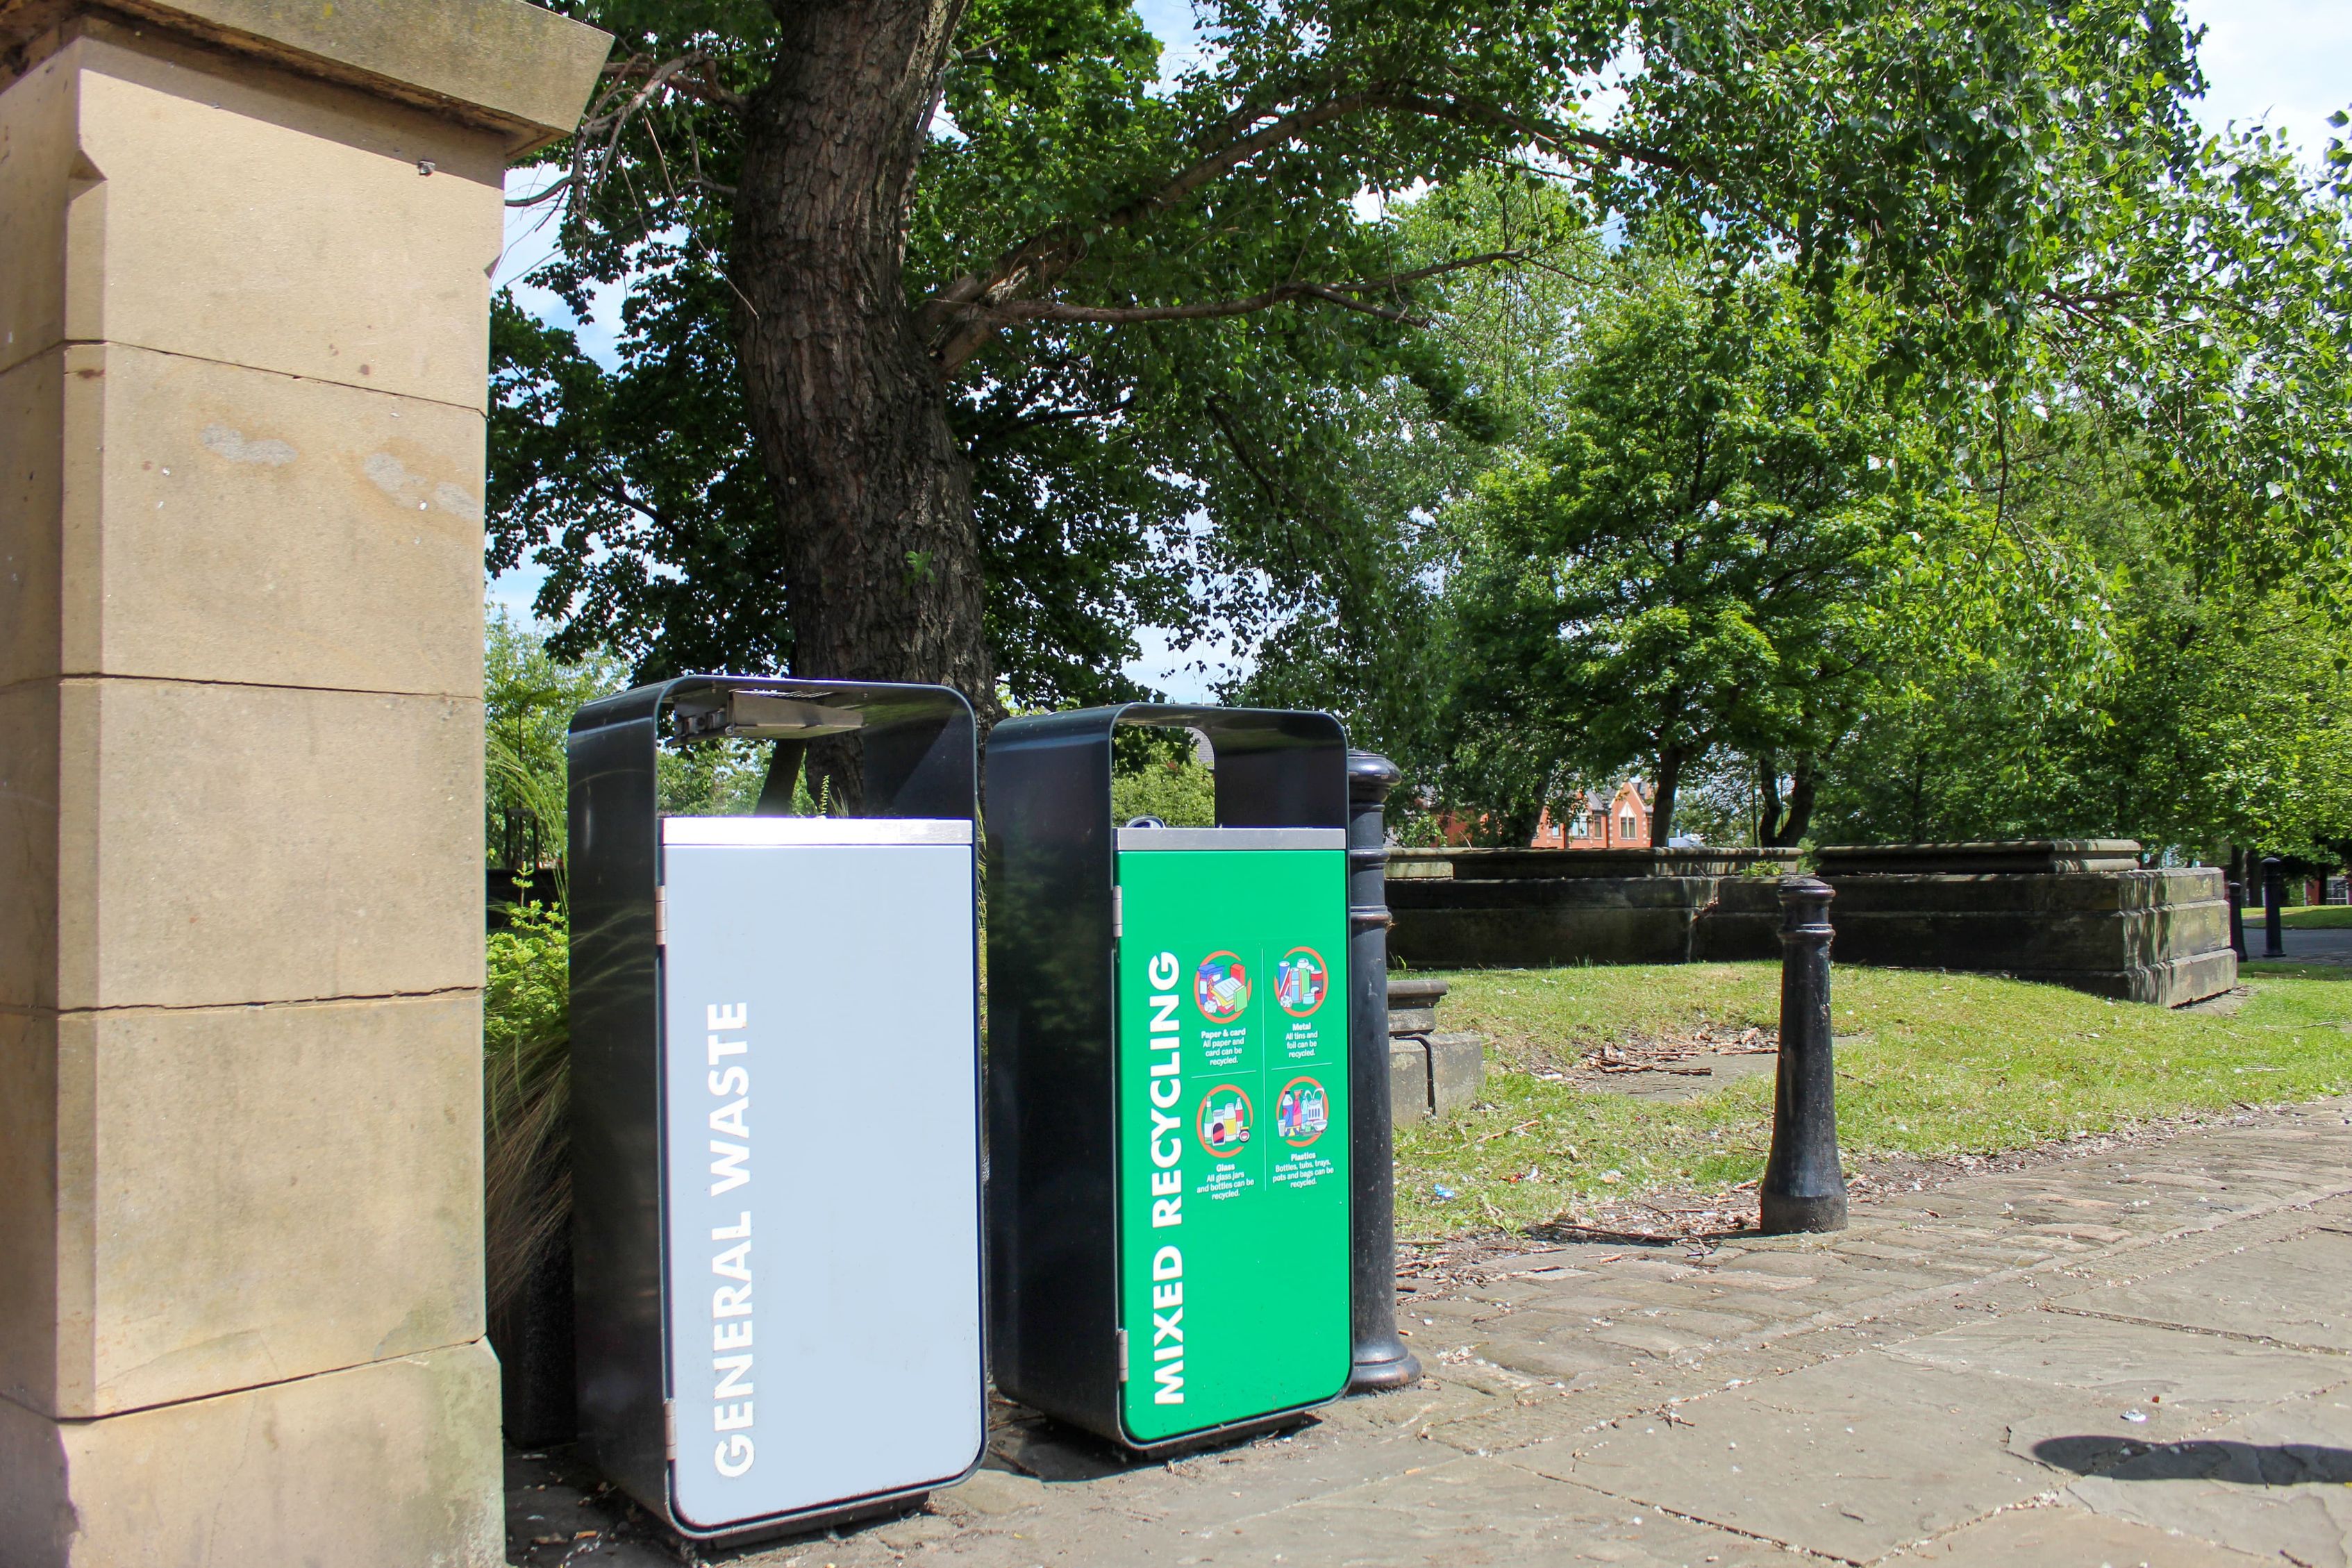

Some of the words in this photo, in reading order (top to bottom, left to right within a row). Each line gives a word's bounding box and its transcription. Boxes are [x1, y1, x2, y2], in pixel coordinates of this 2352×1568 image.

[1292, 1022, 1311, 1031] Metal
[1201, 1031, 1221, 1040] Paper
[1230, 1028, 1246, 1036] card
[1307, 1030, 1318, 1038] and
[1233, 1037, 1244, 1045] and
[1206, 1048, 1220, 1056] card
[1289, 1049, 1315, 1058] recycled.
[1210, 1056, 1238, 1066] recycled.
[1149, 951, 1181, 1228] RECYCLING
[707, 1002, 751, 1197] WASTE
[1291, 1152, 1316, 1161] Plastics
[1206, 1174, 1215, 1183] All
[1216, 1173, 1231, 1183] glass
[1233, 1171, 1244, 1181] jars
[1273, 1174, 1286, 1183] pots
[1287, 1171, 1299, 1180] and
[1290, 1177, 1317, 1188] recycled.
[1197, 1184, 1209, 1193] and
[1210, 1182, 1233, 1191] bottles
[1212, 1189, 1240, 1200] recycled.
[1153, 1245, 1184, 1404] MIXED
[712, 1210, 756, 1477] GENERAL
